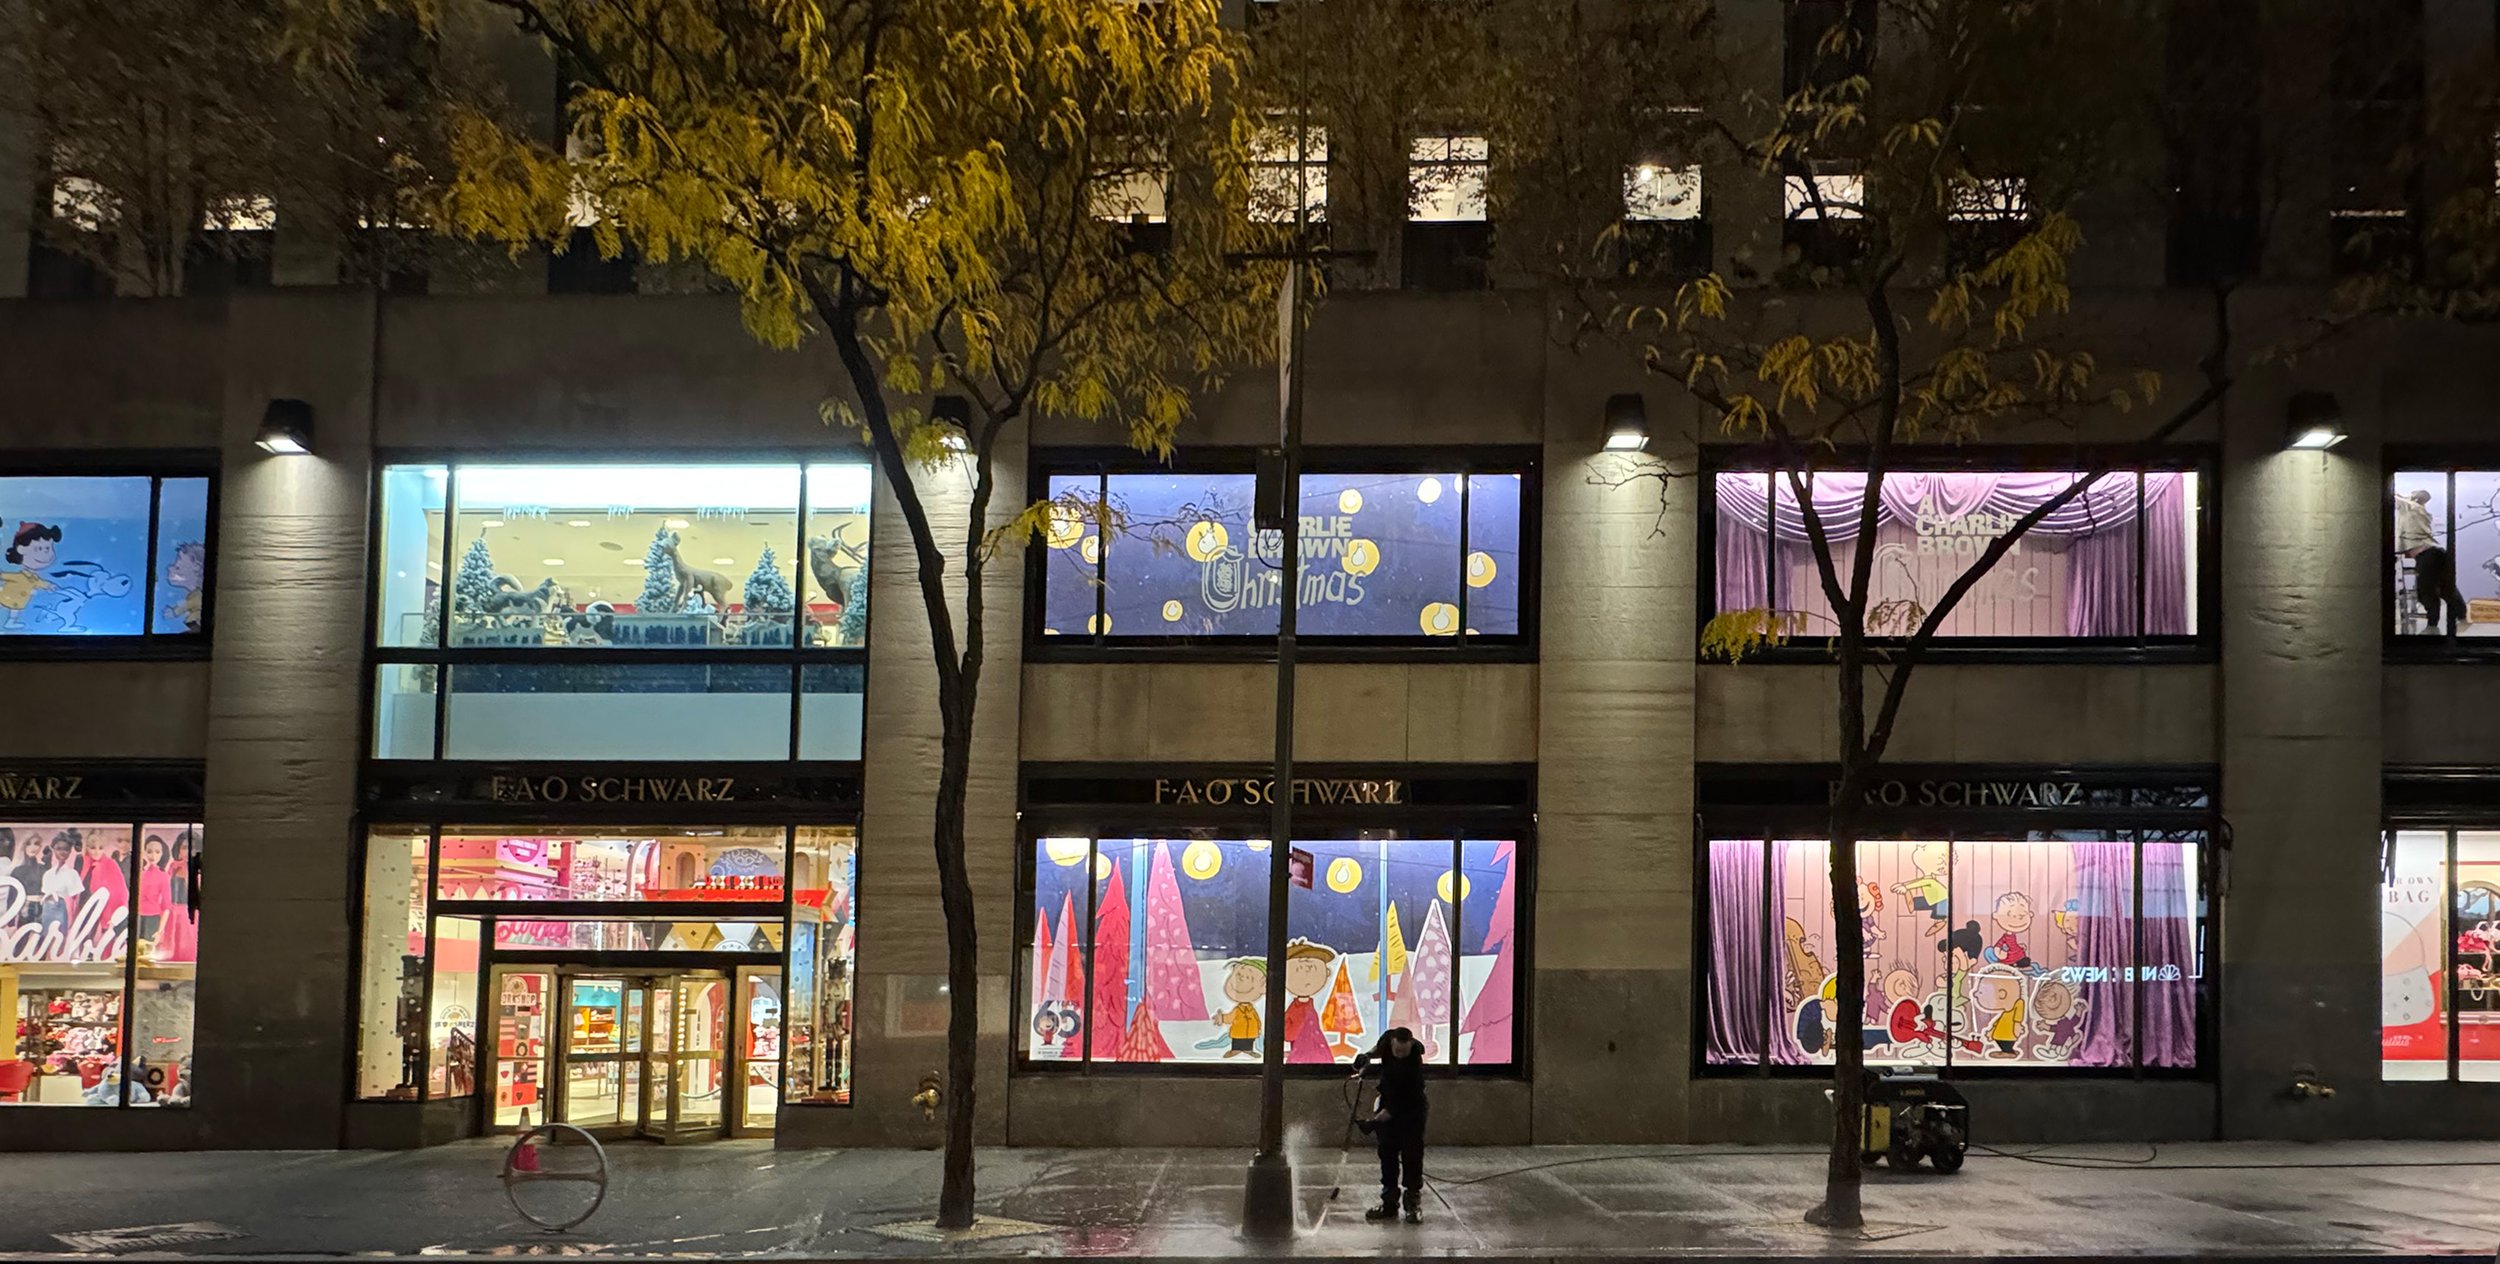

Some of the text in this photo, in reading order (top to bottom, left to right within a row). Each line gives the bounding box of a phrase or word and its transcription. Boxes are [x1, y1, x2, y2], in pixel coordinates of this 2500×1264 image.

[1247, 516, 1352, 538] CRLIE
[1915, 514, 2023, 536] CHARLIE
[1248, 538, 1349, 559] BRWN
[1202, 545, 1365, 613] Chritmas
[580, 777, 735, 801] SCHWARZ
[1918, 780, 2081, 806] SCHWARZ
[2389, 890, 2430, 903] BAG
